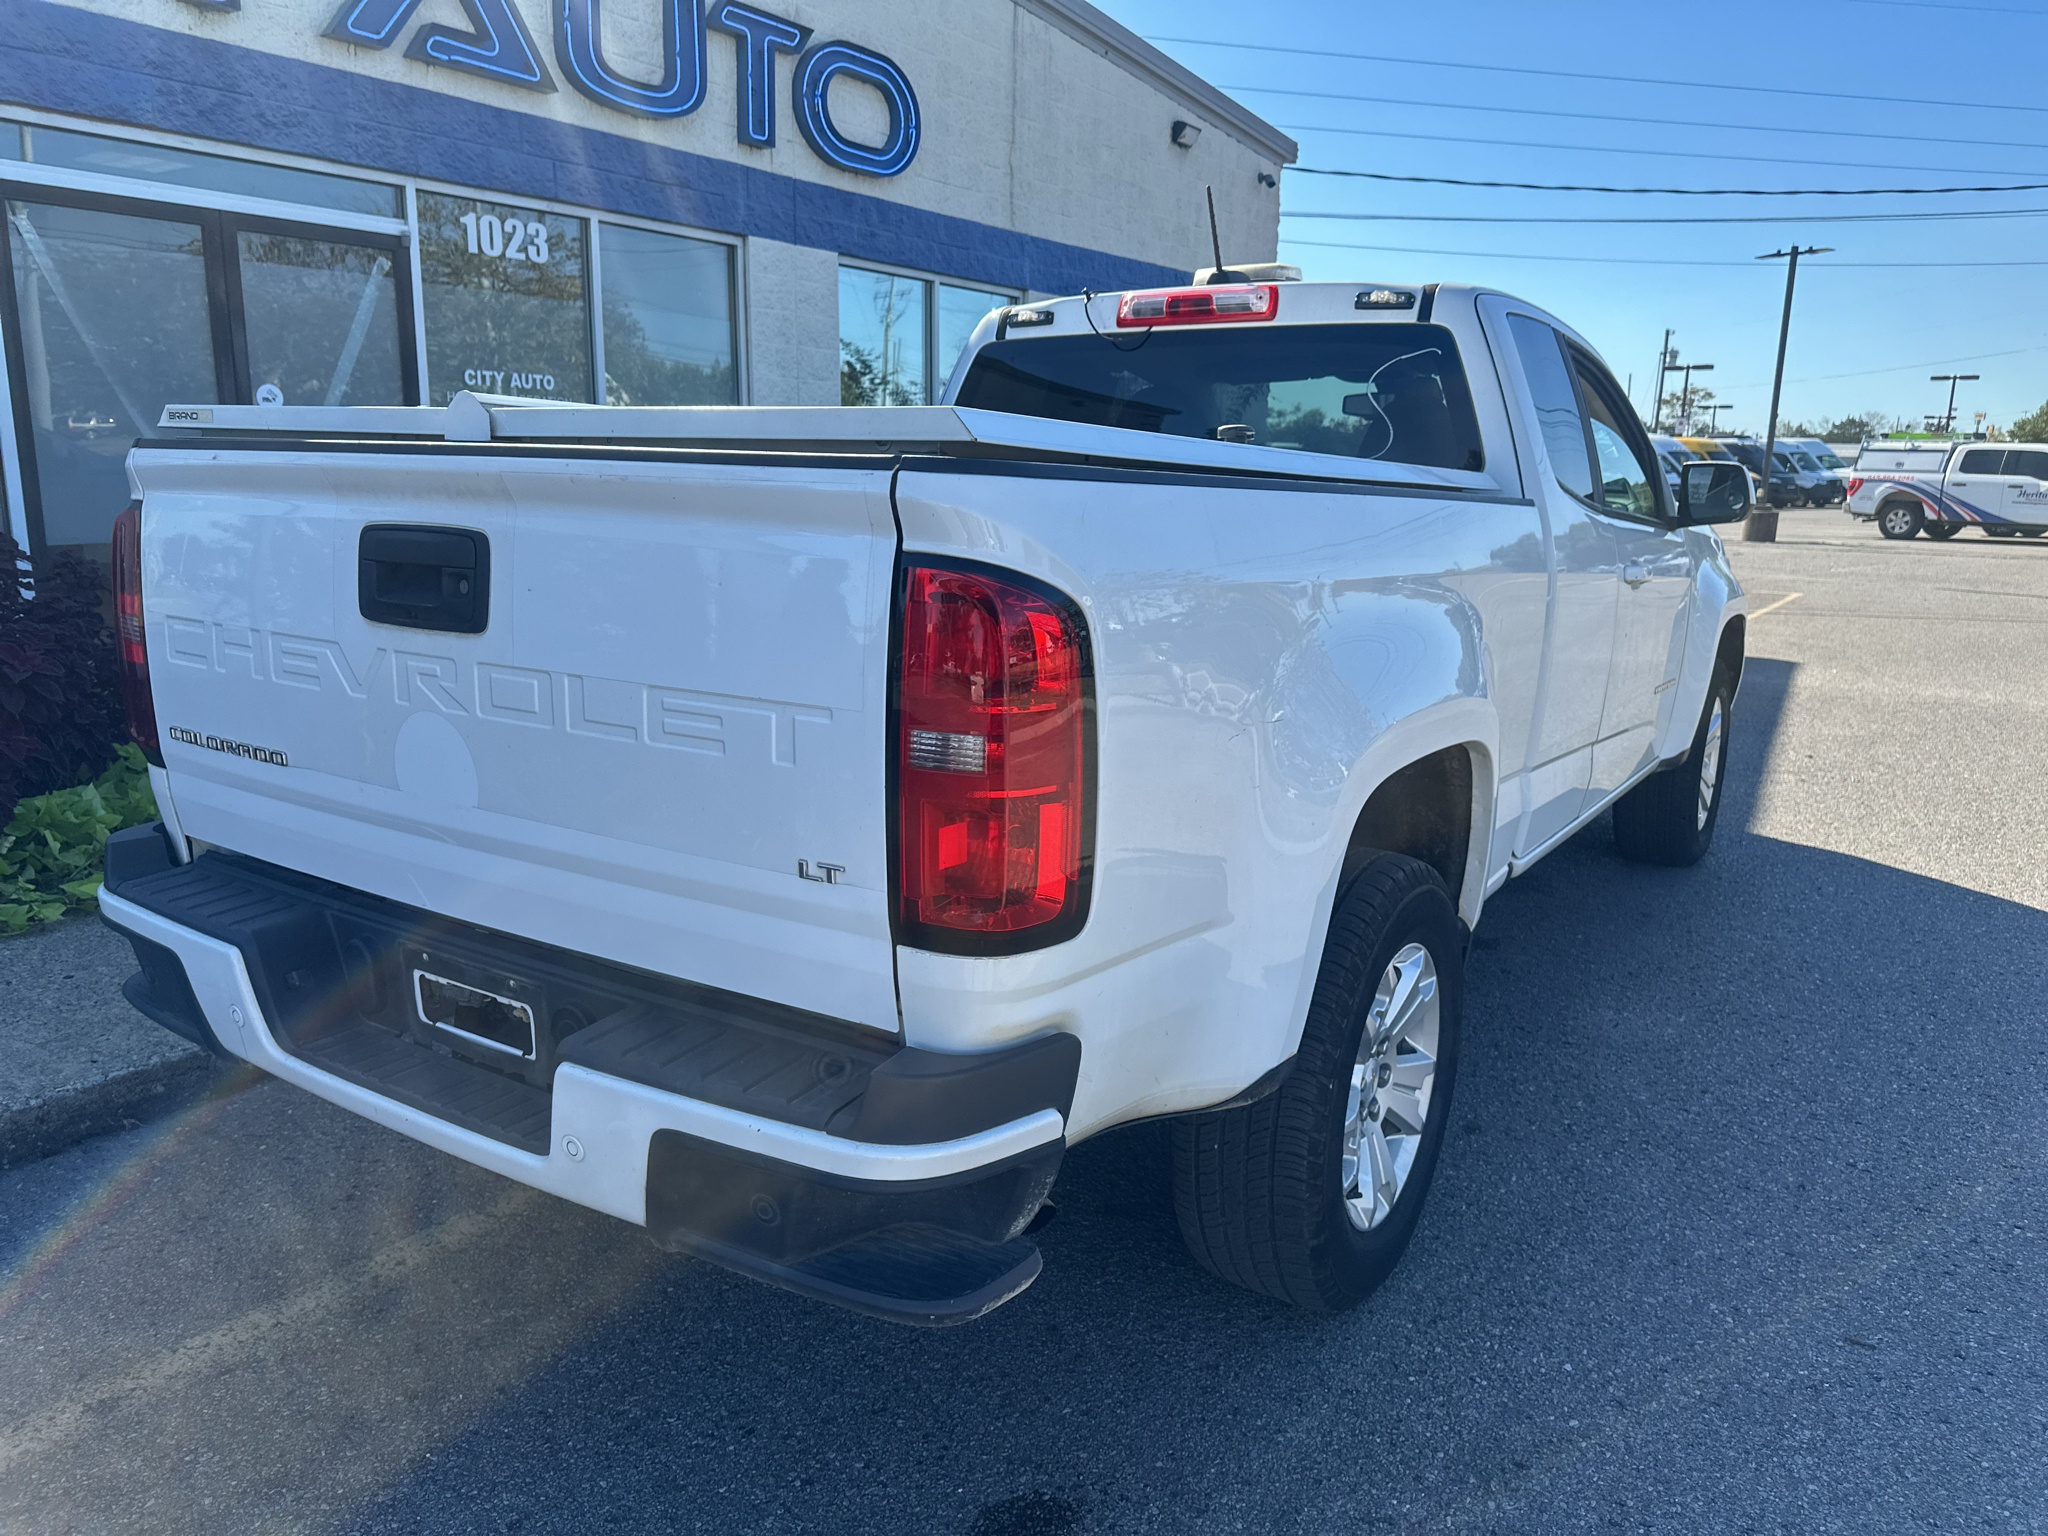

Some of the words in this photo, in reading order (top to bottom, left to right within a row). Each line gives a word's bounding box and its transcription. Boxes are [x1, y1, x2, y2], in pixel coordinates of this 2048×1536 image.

[460, 212, 549, 264] 1023
[464, 369, 504, 387] CITY
[510, 372, 555, 390] AUTO
[165, 614, 833, 767] CHEVROLET
[169, 725, 289, 767] COLORADO
[798, 858, 846, 884] LT
